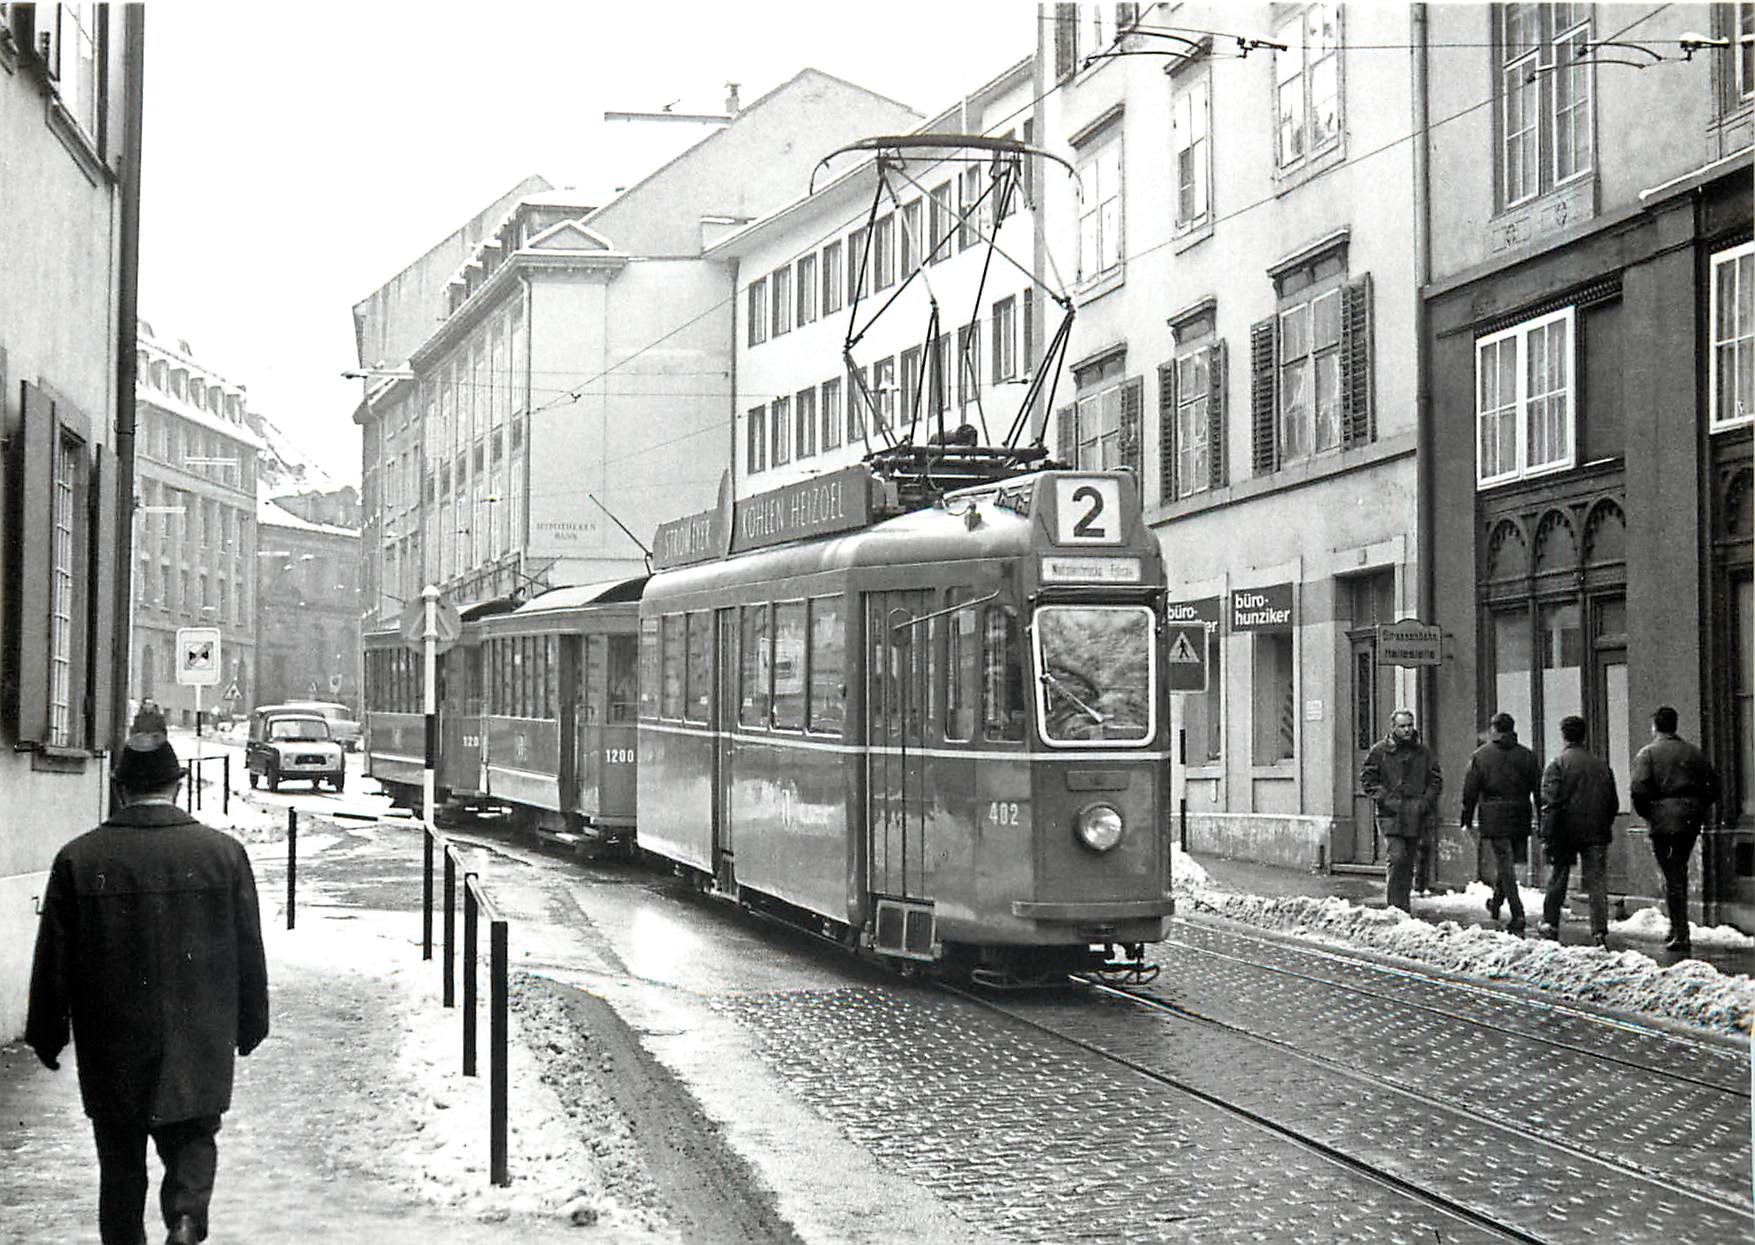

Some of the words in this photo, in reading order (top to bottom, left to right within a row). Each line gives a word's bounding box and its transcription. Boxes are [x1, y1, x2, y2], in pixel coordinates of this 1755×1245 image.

[742, 499, 785, 539] KOHLEN
[791, 480, 845, 528] HEIZOEL
[1071, 486, 1105, 538] 2
[1235, 593, 1270, 609] büro-
[1167, 604, 1199, 620] büro-
[1234, 607, 1291, 626] hunziker
[605, 749, 635, 763] 1200
[988, 801, 1019, 825] 402
